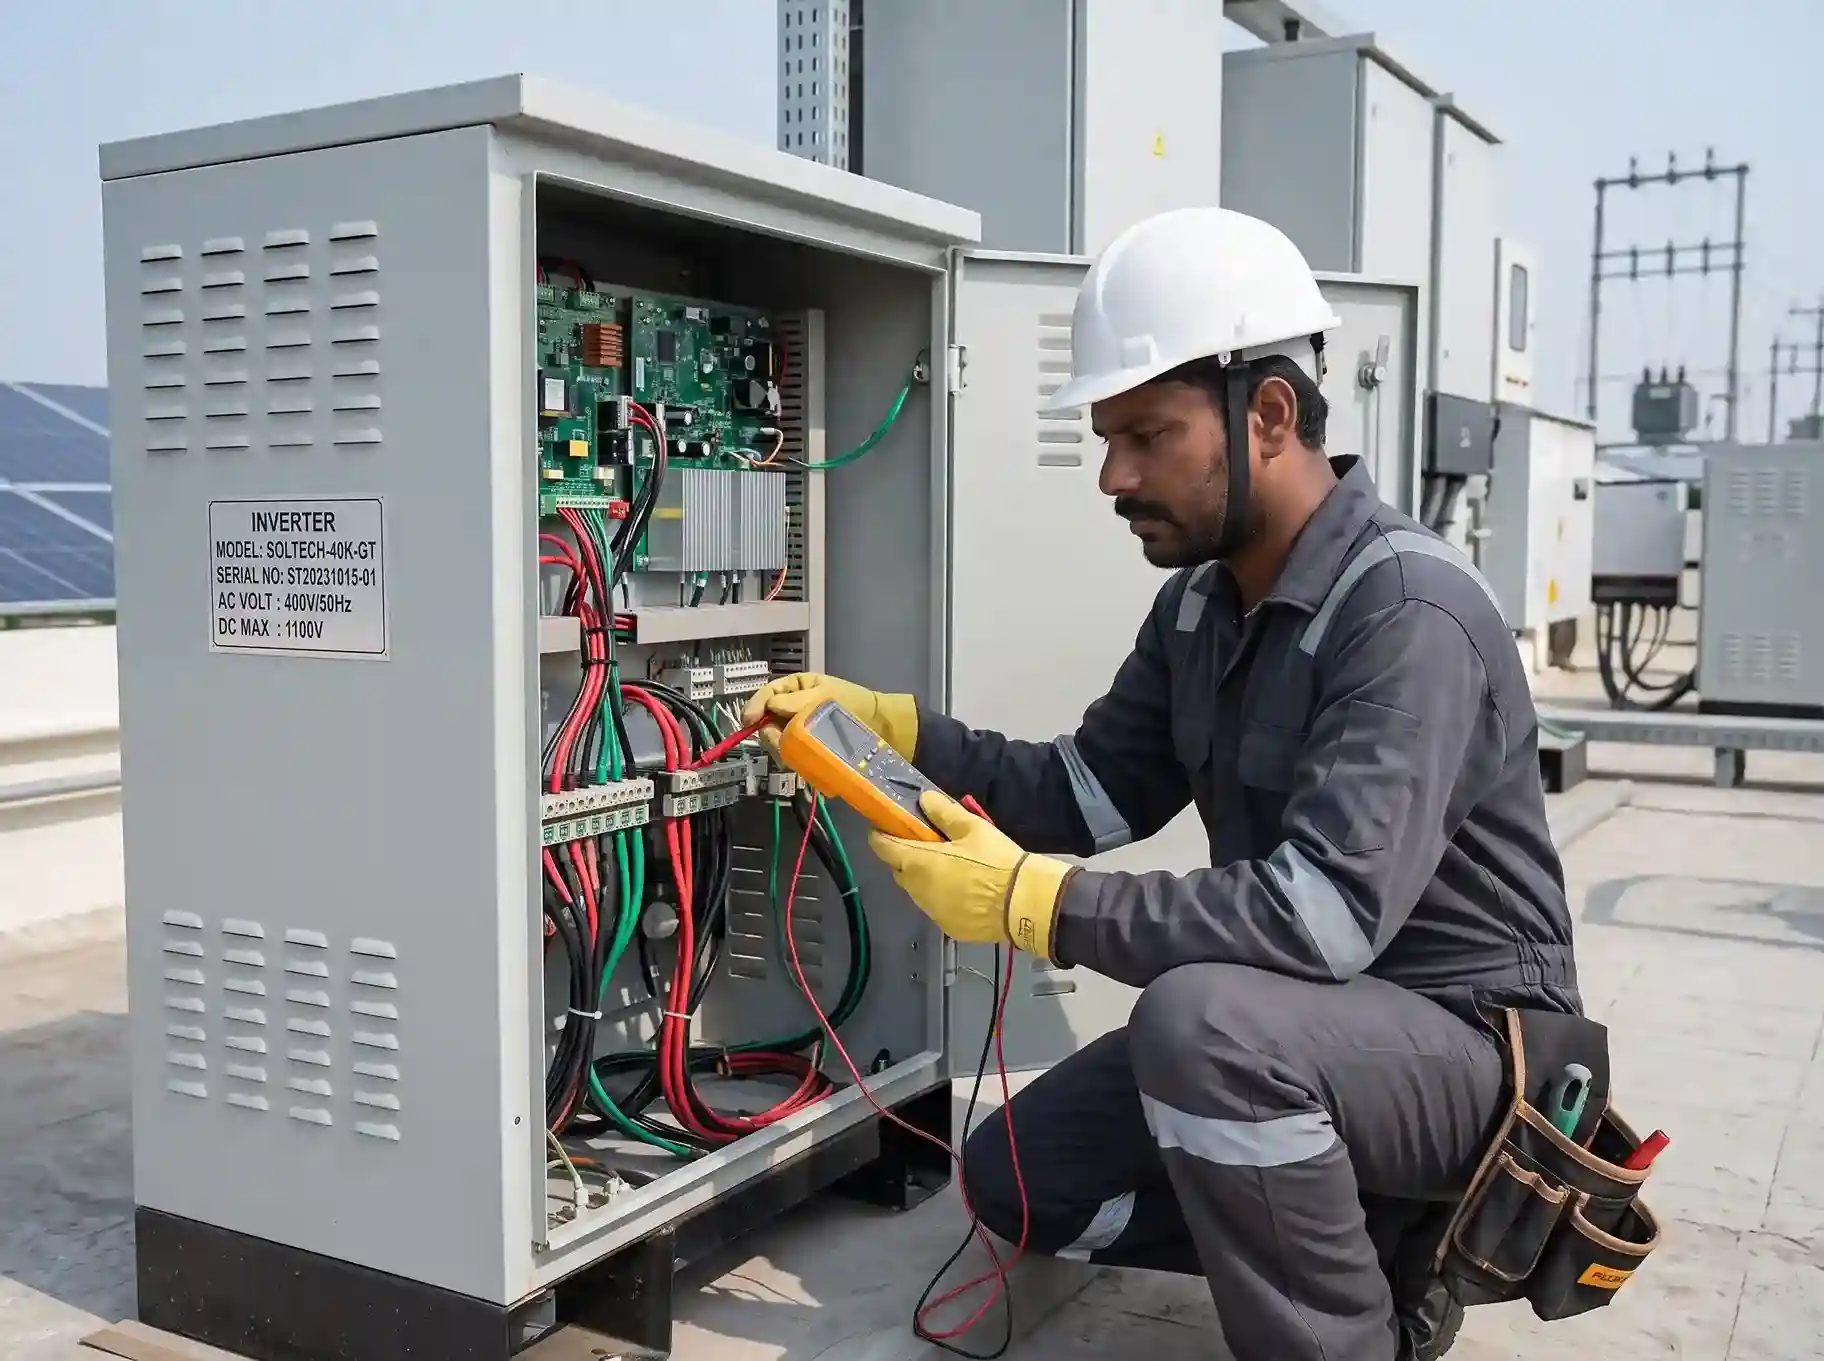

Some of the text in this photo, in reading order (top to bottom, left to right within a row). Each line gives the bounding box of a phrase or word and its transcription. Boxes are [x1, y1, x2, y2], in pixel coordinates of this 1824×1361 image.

[252, 512, 336, 532] INVERTER
[216, 541, 377, 559] MODEL: SOLTECH-40K-GT
[216, 566, 376, 586] SERIAL NO: ST20231015-01
[218, 592, 236, 609] AC
[239, 592, 273, 610] VOLT
[284, 593, 352, 612] 400V/50Hz
[218, 618, 237, 635] DC
[240, 618, 270, 636] MAX
[285, 620, 324, 639] 1100V
